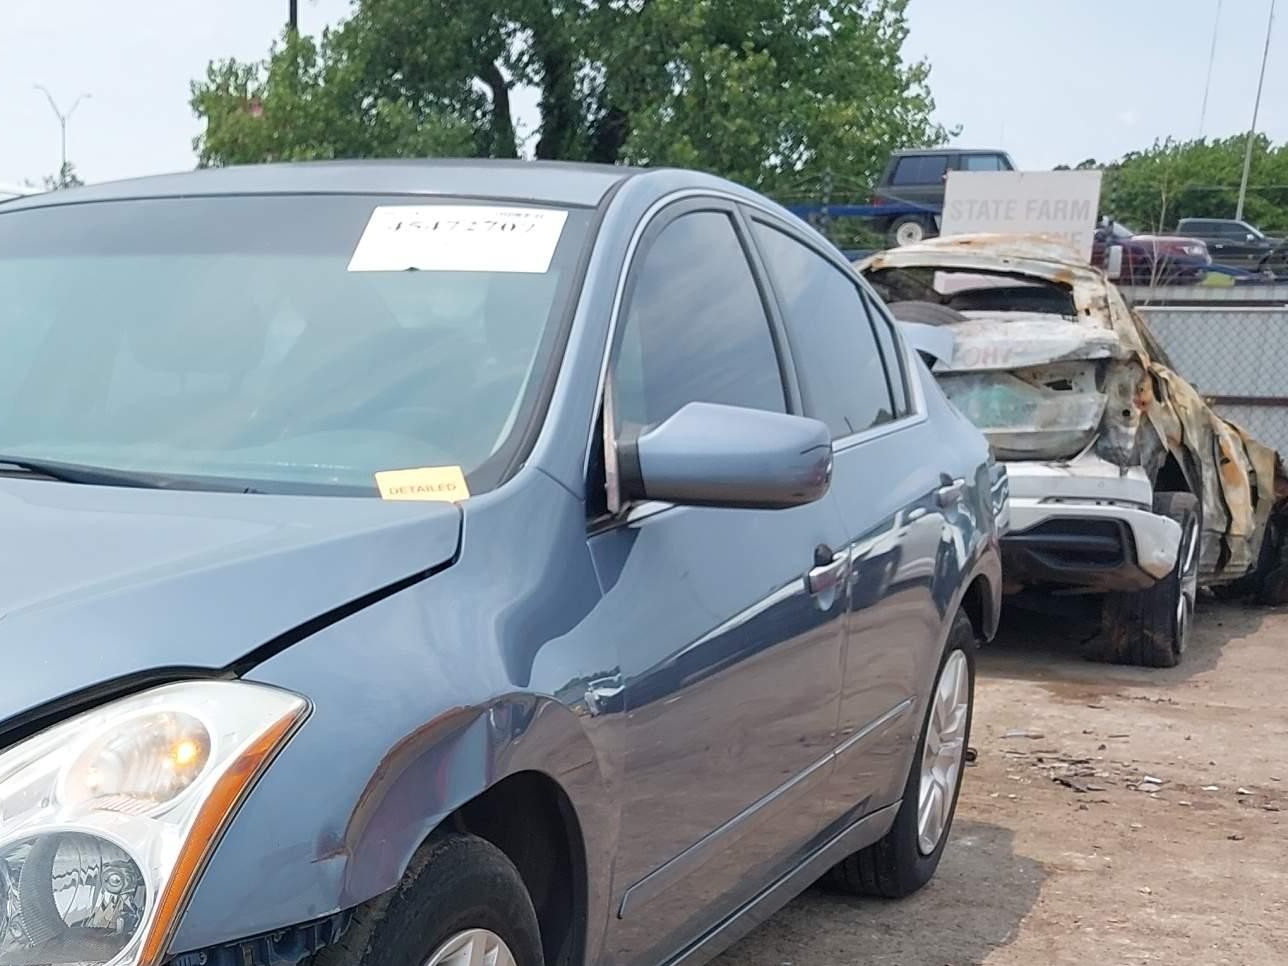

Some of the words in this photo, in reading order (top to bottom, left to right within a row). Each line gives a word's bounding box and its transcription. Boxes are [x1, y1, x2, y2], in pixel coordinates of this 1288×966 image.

[950, 199, 1017, 221] STATE
[1025, 199, 1091, 221] FARM
[388, 483, 457, 495] DETAILED
